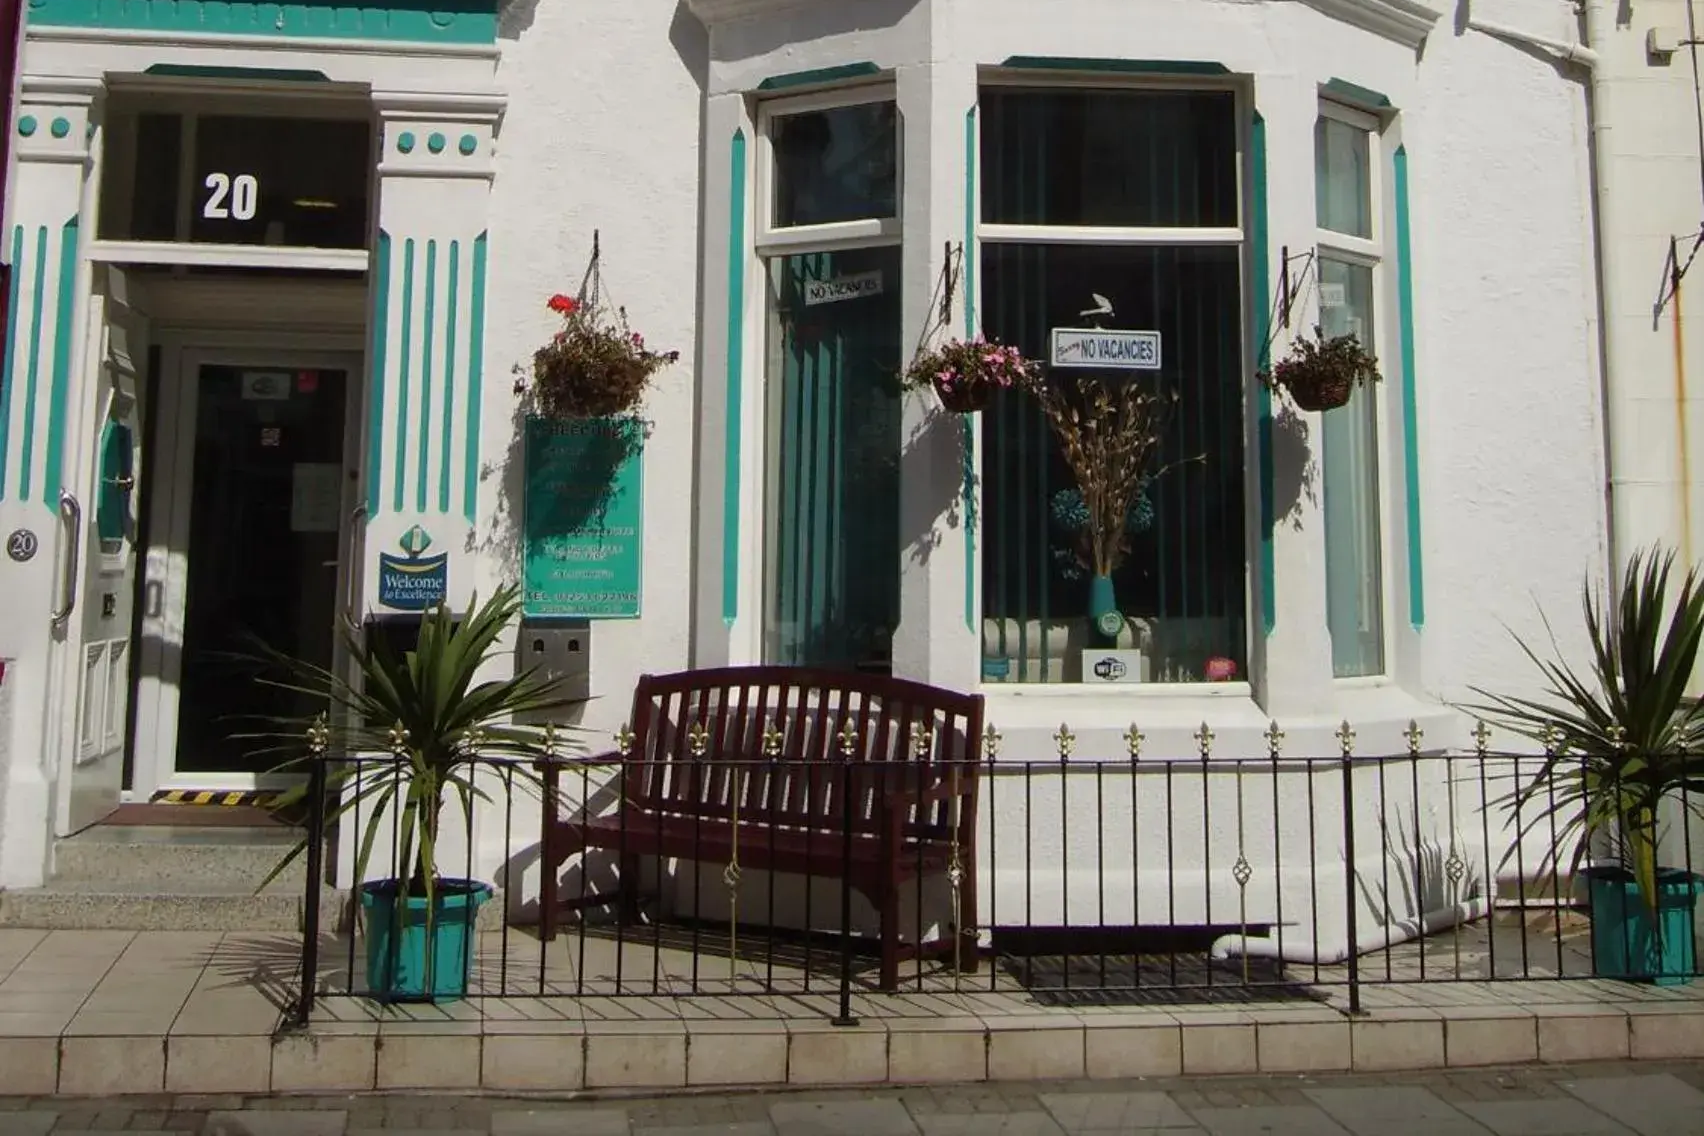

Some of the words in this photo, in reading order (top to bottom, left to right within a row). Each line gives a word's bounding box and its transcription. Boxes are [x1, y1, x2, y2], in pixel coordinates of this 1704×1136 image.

[204, 172, 258, 220] 20
[810, 285, 828, 300] NO
[1081, 338, 1096, 359] NO
[1097, 339, 1154, 361] VACANCIES
[11, 534, 34, 552] 20
[384, 573, 443, 590] Welcome
